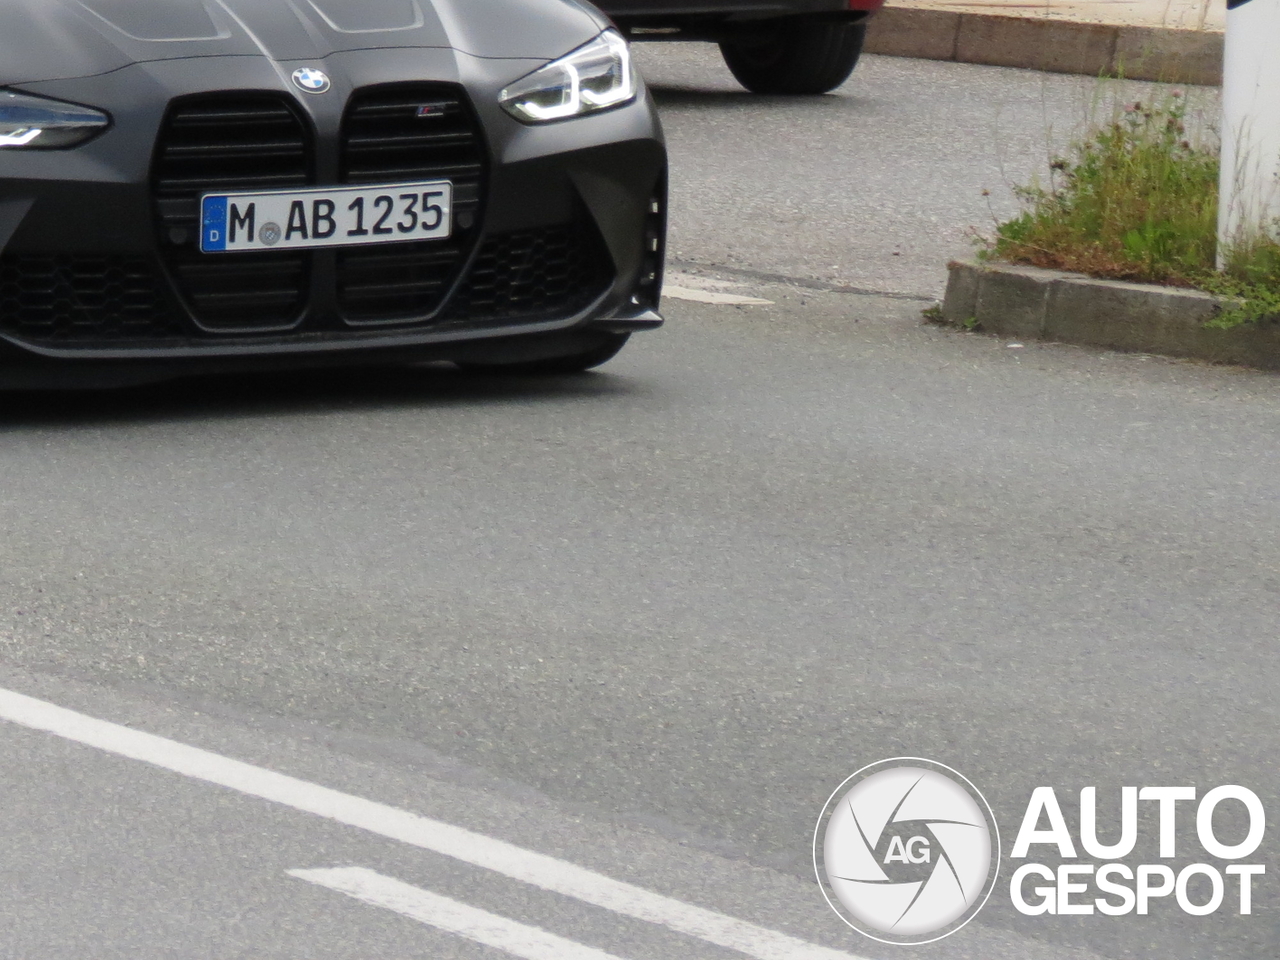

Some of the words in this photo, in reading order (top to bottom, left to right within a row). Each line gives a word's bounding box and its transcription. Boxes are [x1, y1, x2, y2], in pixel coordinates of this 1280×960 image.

[209, 229, 220, 242] D
[228, 202, 256, 243] M
[284, 198, 337, 240] AB
[347, 191, 444, 237] 1235
